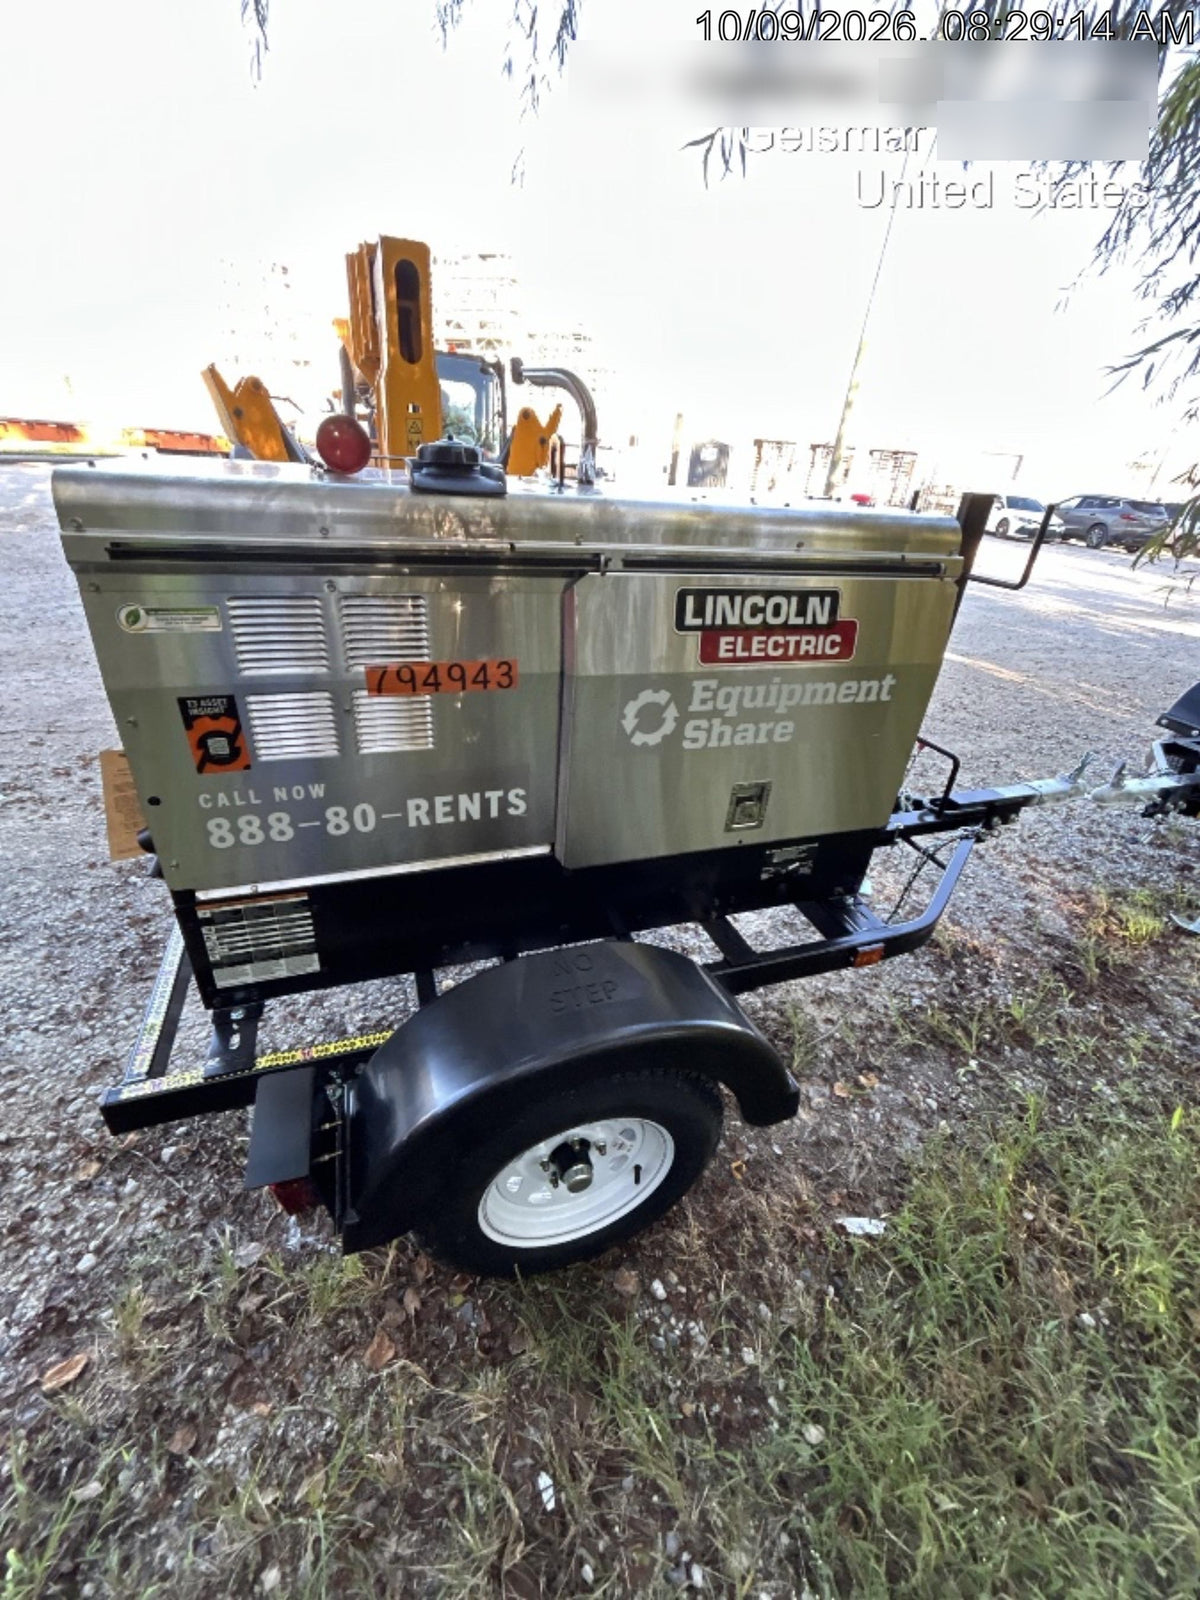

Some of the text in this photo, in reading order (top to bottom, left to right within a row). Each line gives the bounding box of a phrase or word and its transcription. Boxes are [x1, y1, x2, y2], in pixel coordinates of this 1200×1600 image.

[684, 594, 831, 627] LINCOLN
[717, 634, 842, 659] ELECTRIC
[375, 660, 514, 694] 794943
[687, 673, 896, 715] Equipment
[682, 718, 795, 750] Share
[198, 783, 327, 810] CALL NOW
[552, 952, 594, 977] NO
[550, 979, 619, 1014] STEP
